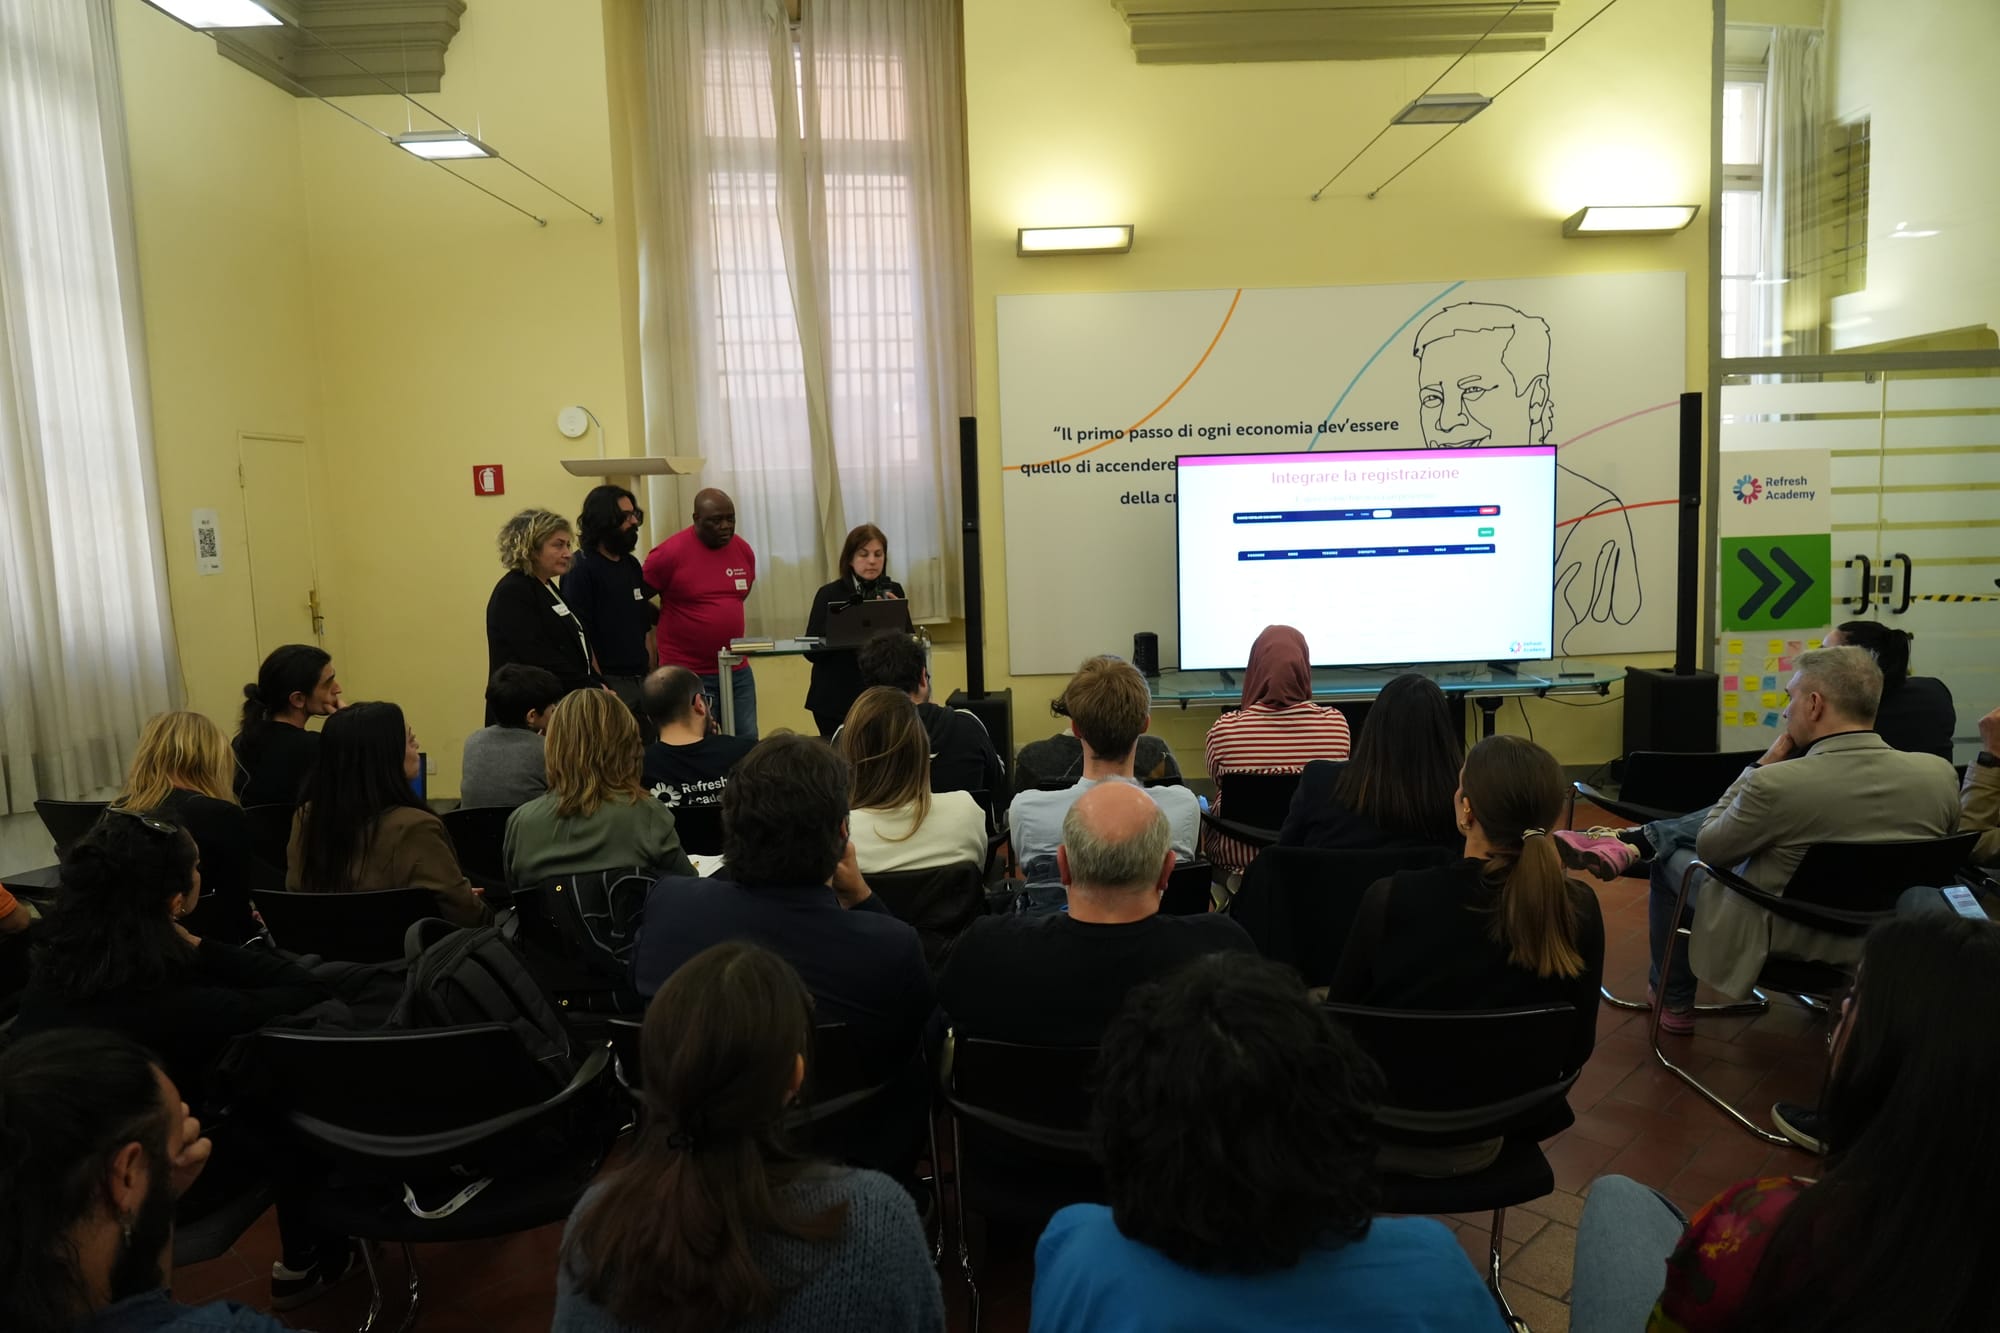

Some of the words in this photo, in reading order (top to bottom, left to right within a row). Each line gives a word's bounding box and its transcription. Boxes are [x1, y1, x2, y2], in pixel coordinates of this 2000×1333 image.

[1077, 427, 1125, 444] primo
[1129, 427, 1174, 443] passo
[1178, 424, 1193, 438] di
[1197, 423, 1231, 440] ogni
[1236, 420, 1313, 436] economia
[1020, 460, 1072, 477] quello
[1076, 460, 1091, 473] di
[1095, 458, 1176, 473] accendere
[1271, 471, 1340, 487] Integrare
[1344, 469, 1357, 482] la
[1361, 467, 1461, 484] registrazione
[1765, 475, 1808, 488] Refresh
[1120, 490, 1160, 505] della
[1164, 493, 1177, 504] c
[1765, 489, 1816, 502] Academy
[681, 776, 728, 794] Refresh
